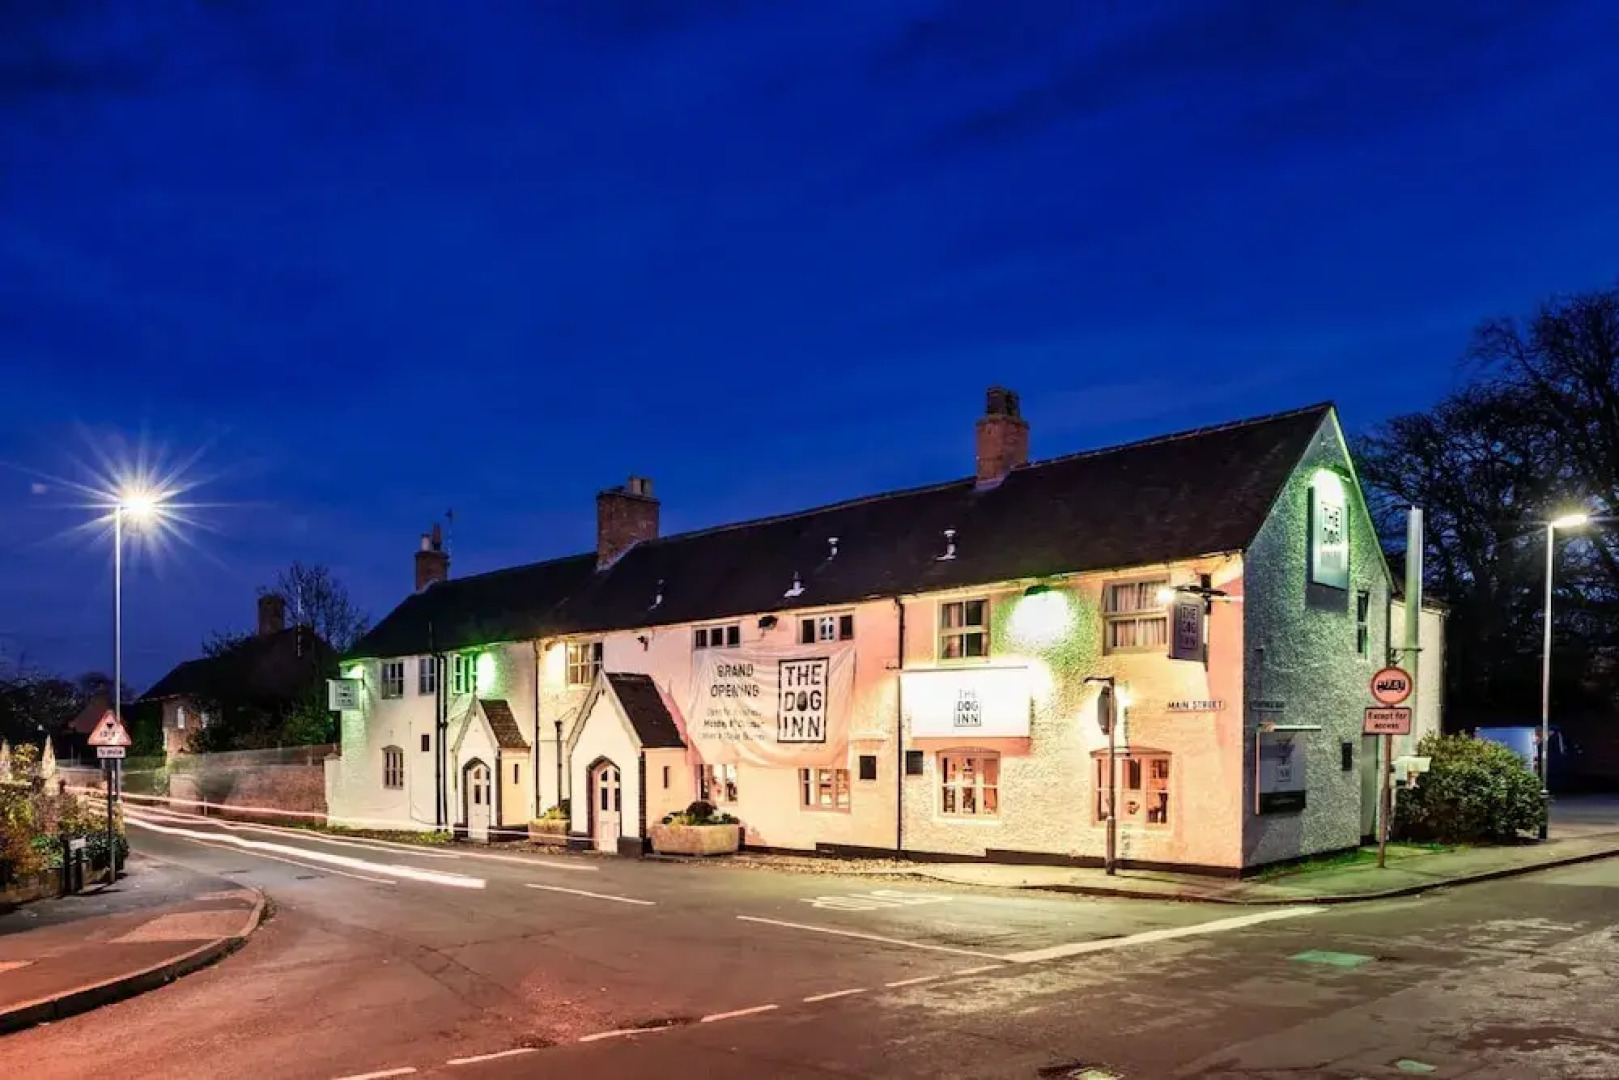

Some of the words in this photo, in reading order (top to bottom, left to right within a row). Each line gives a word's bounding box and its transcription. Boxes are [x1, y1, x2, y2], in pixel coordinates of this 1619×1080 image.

[717, 664, 753, 678] GRAND
[784, 664, 822, 686] THE
[711, 684, 760, 697] OPENING
[784, 690, 822, 711] DOG
[957, 701, 978, 711] DOG
[1168, 701, 1189, 709] MAIN
[957, 714, 978, 724] INN
[784, 716, 821, 738] INN
